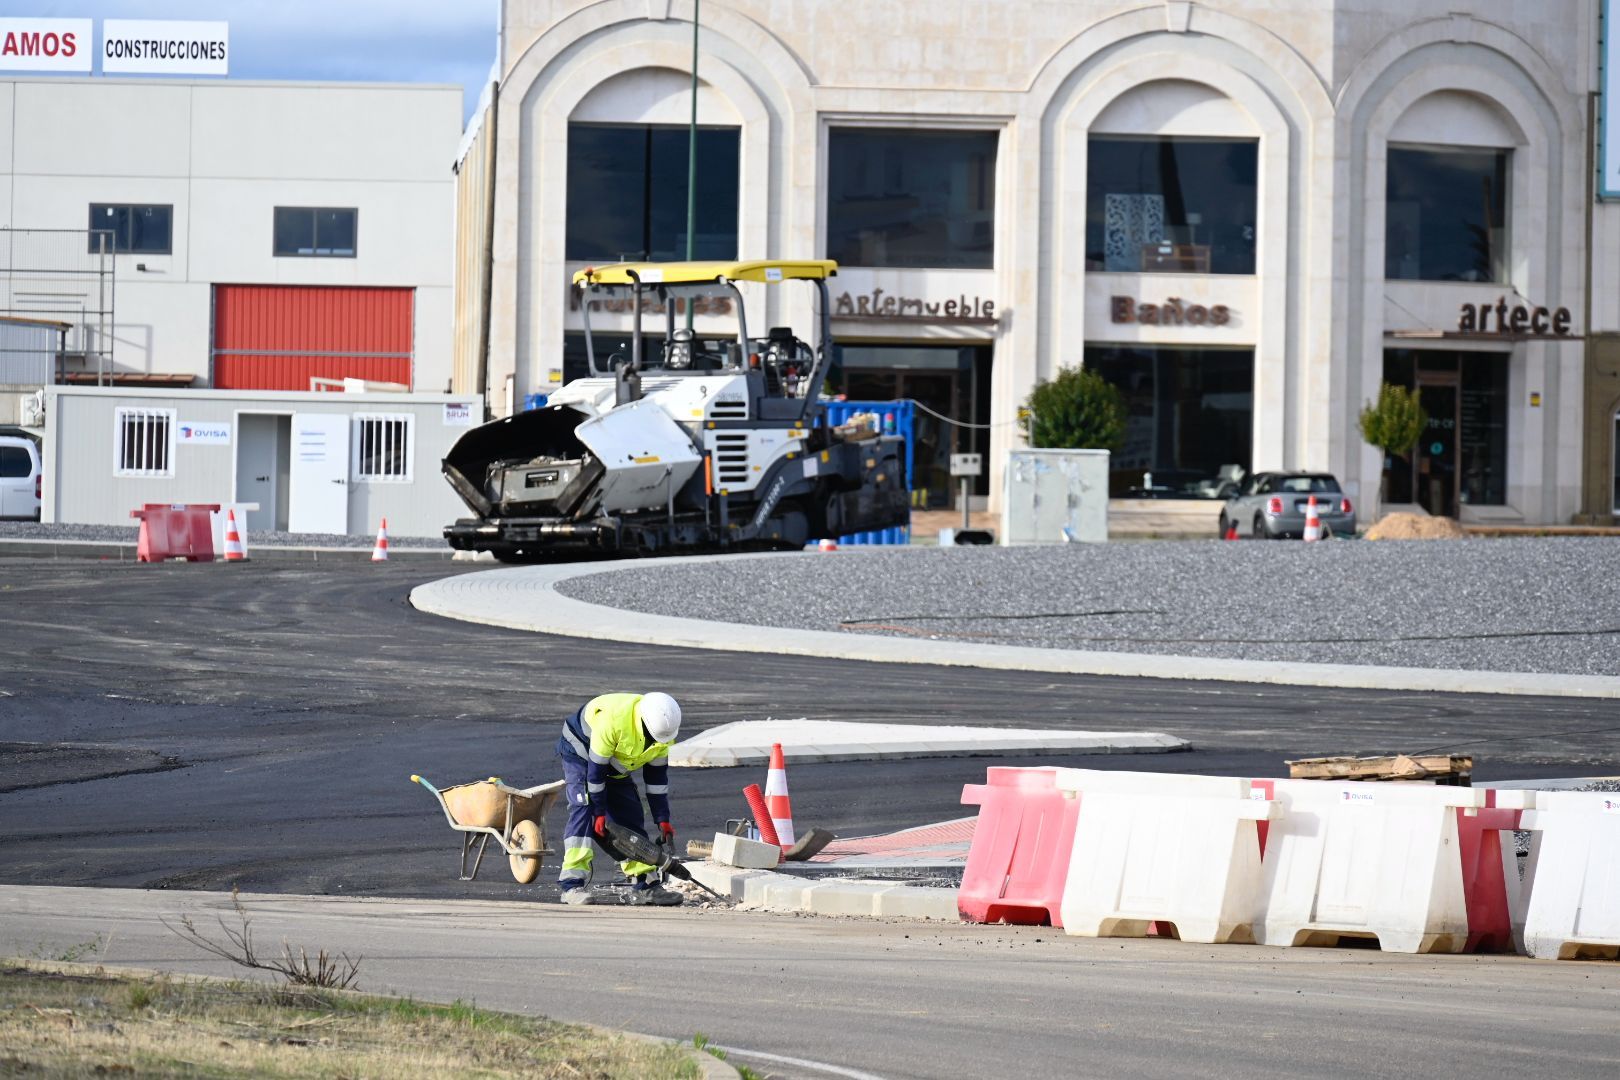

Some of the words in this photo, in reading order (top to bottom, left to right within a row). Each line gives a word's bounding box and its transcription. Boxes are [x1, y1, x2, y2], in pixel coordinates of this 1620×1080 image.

[2, 32, 77, 57] AMOS
[106, 39, 226, 60] CONSTRUCCIONES
[1110, 295, 1230, 326] Baños
[1459, 296, 1571, 334] artece
